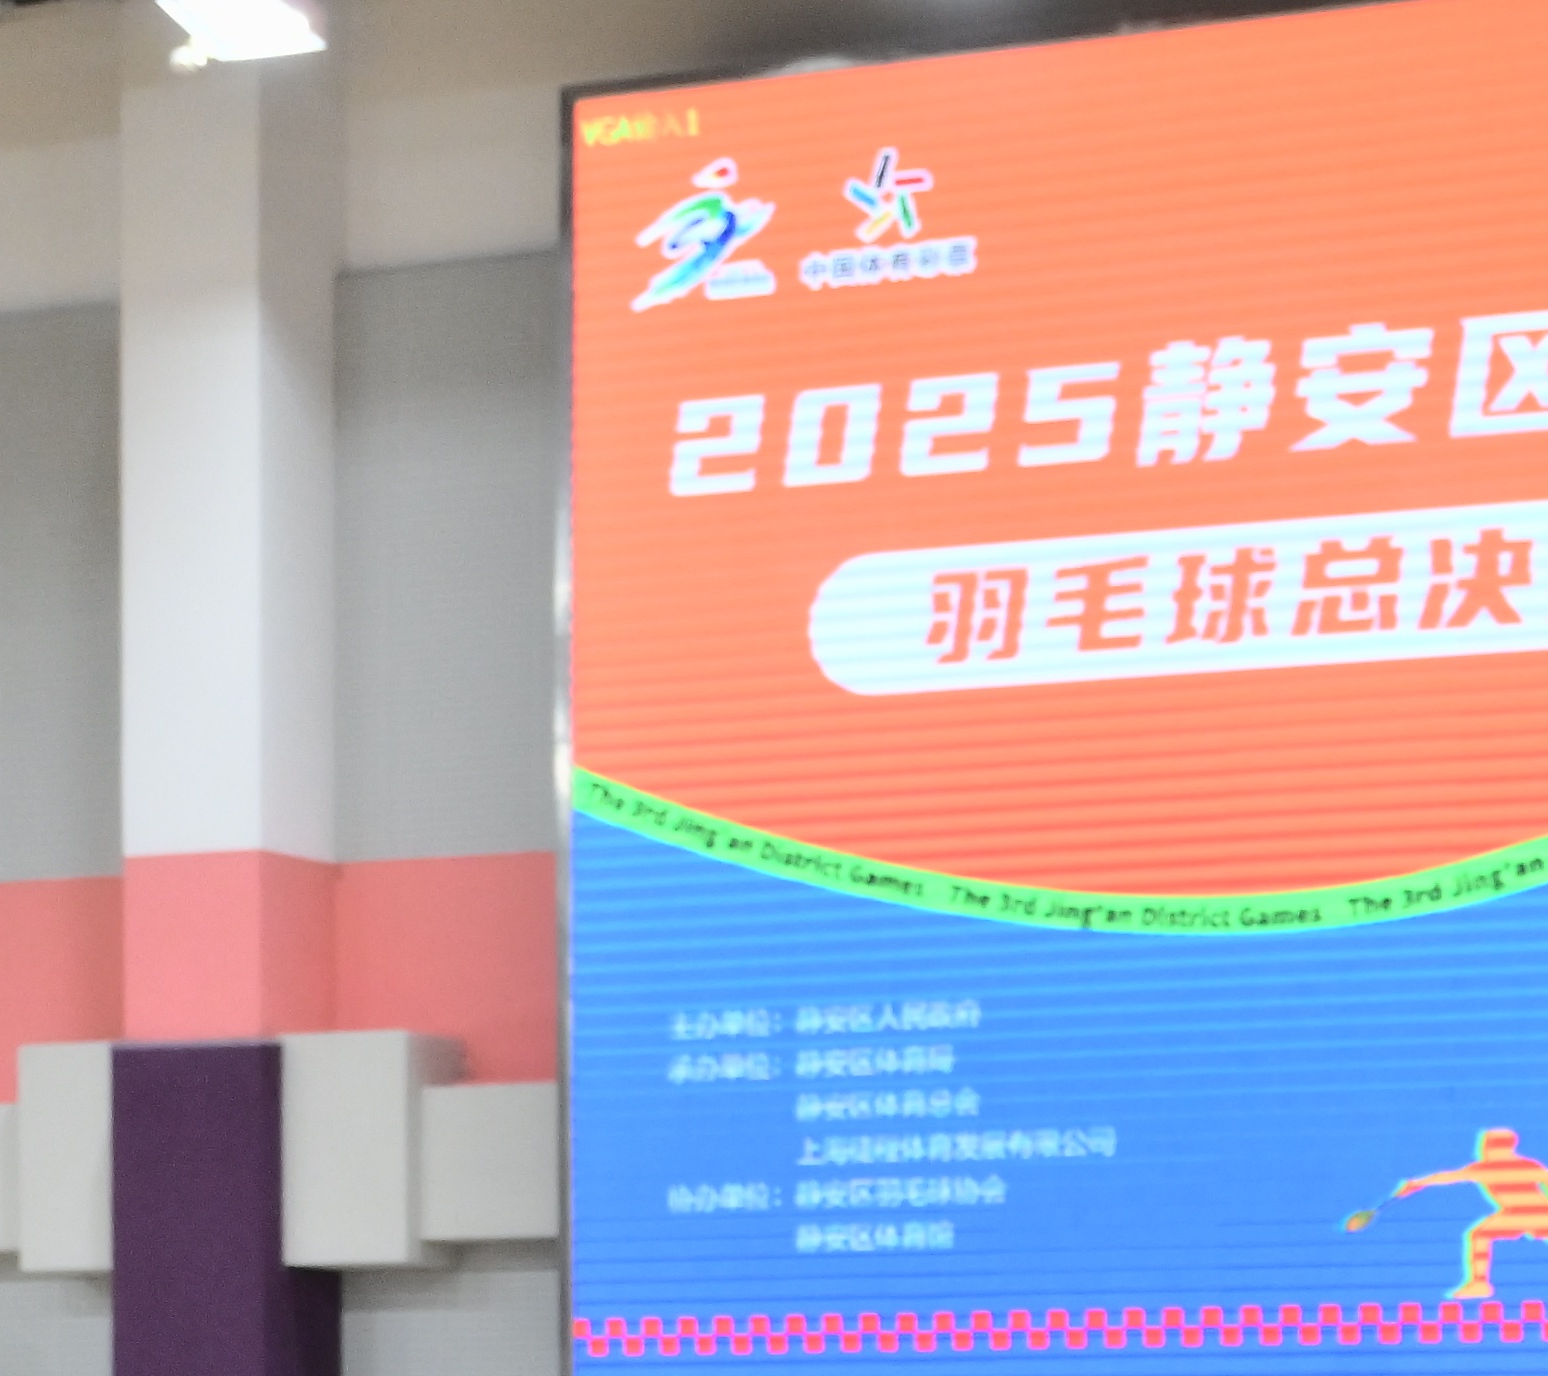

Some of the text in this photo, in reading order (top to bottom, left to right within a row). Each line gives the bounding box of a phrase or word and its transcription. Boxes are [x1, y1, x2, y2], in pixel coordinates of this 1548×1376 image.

[591, 783, 924, 897] The 3rd Jingan District Games
[951, 884, 991, 909] The
[999, 892, 1038, 916] 3rd
[1141, 906, 1231, 928] District
[1239, 906, 1323, 928] Games
[1348, 894, 1393, 918] The
[1402, 882, 1443, 910] 3rd
